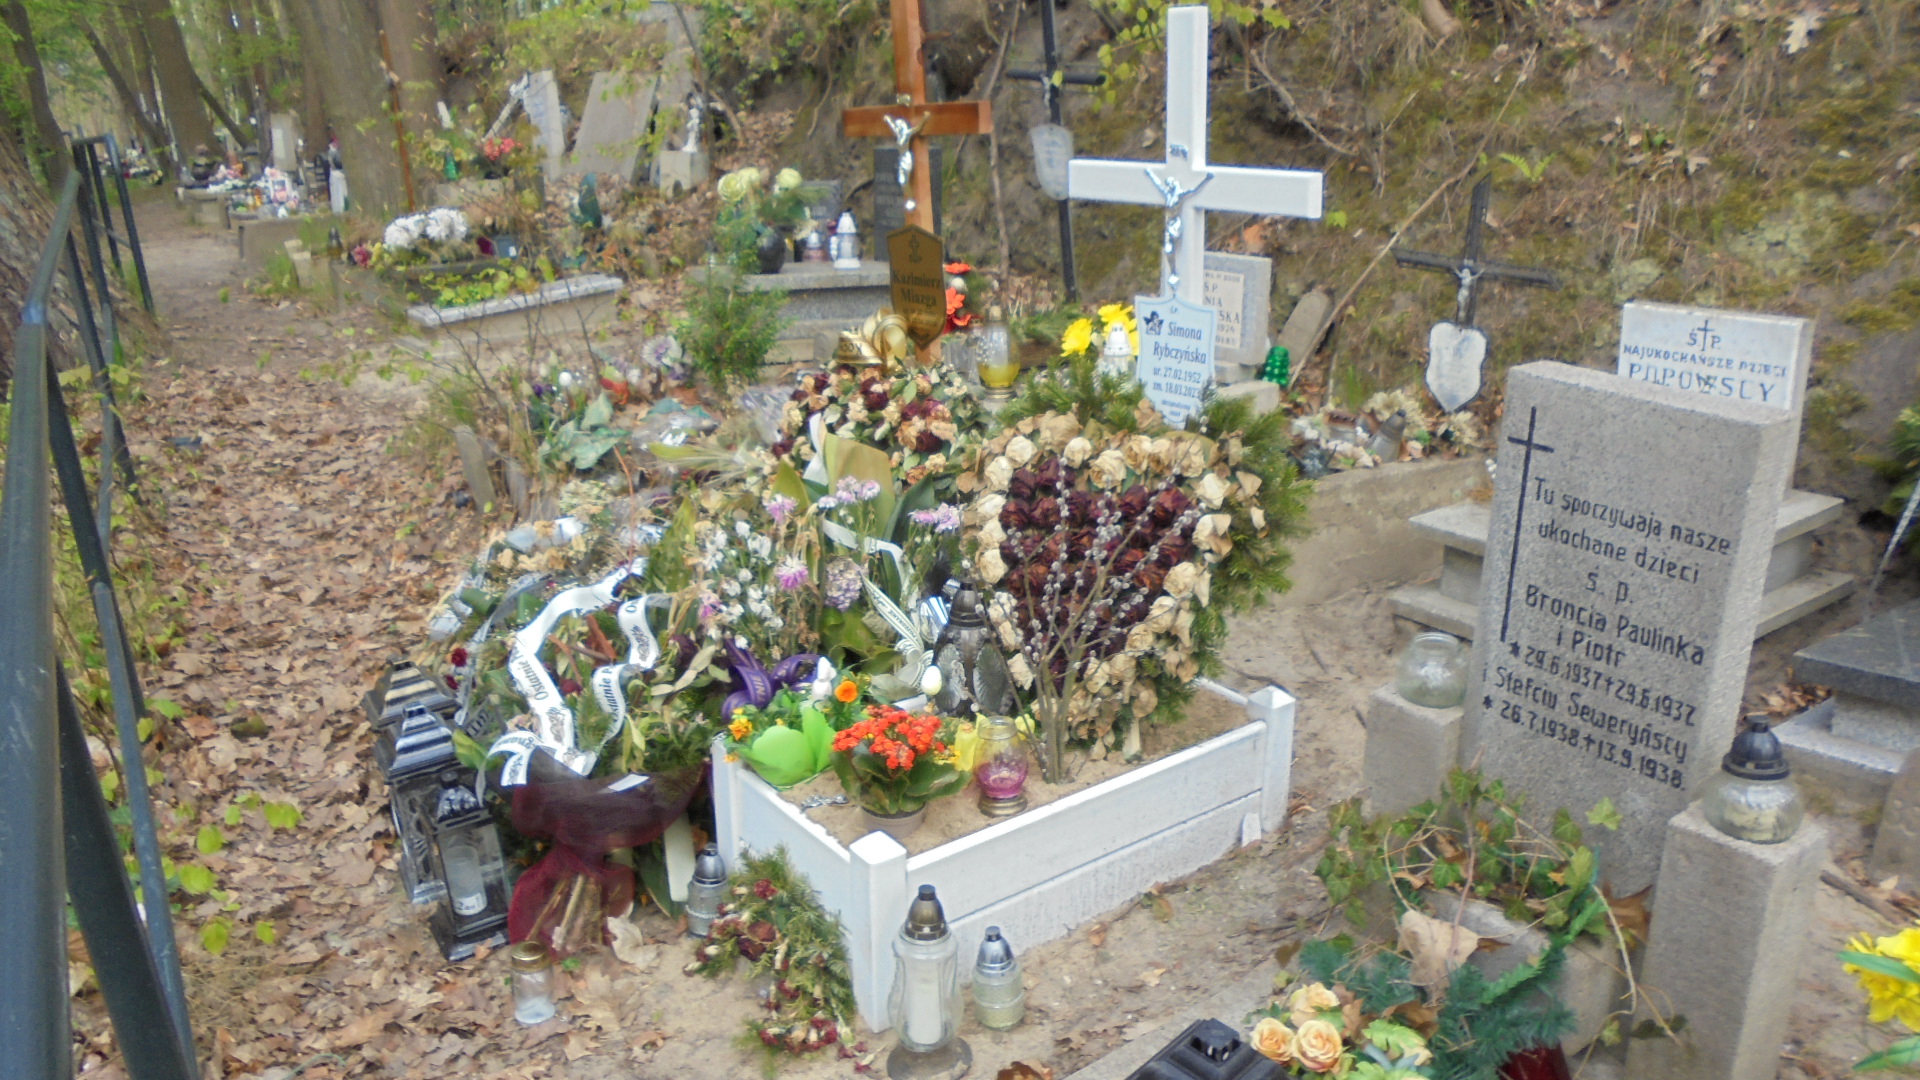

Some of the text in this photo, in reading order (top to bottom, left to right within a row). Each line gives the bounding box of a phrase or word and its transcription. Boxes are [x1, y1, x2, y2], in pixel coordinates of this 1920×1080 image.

[1168, 322, 1202, 340] Simona
[1535, 477, 1555, 505] Tu
[1671, 524, 1731, 555] nasze
[1539, 520, 1700, 584] ukochane dzieci
[1525, 584, 1704, 666] Broncia Paulinka
[1557, 625, 1626, 667] i Piotr
[1495, 666, 1557, 709] Stefciu
[1568, 692, 1687, 764] Seweryńscy
